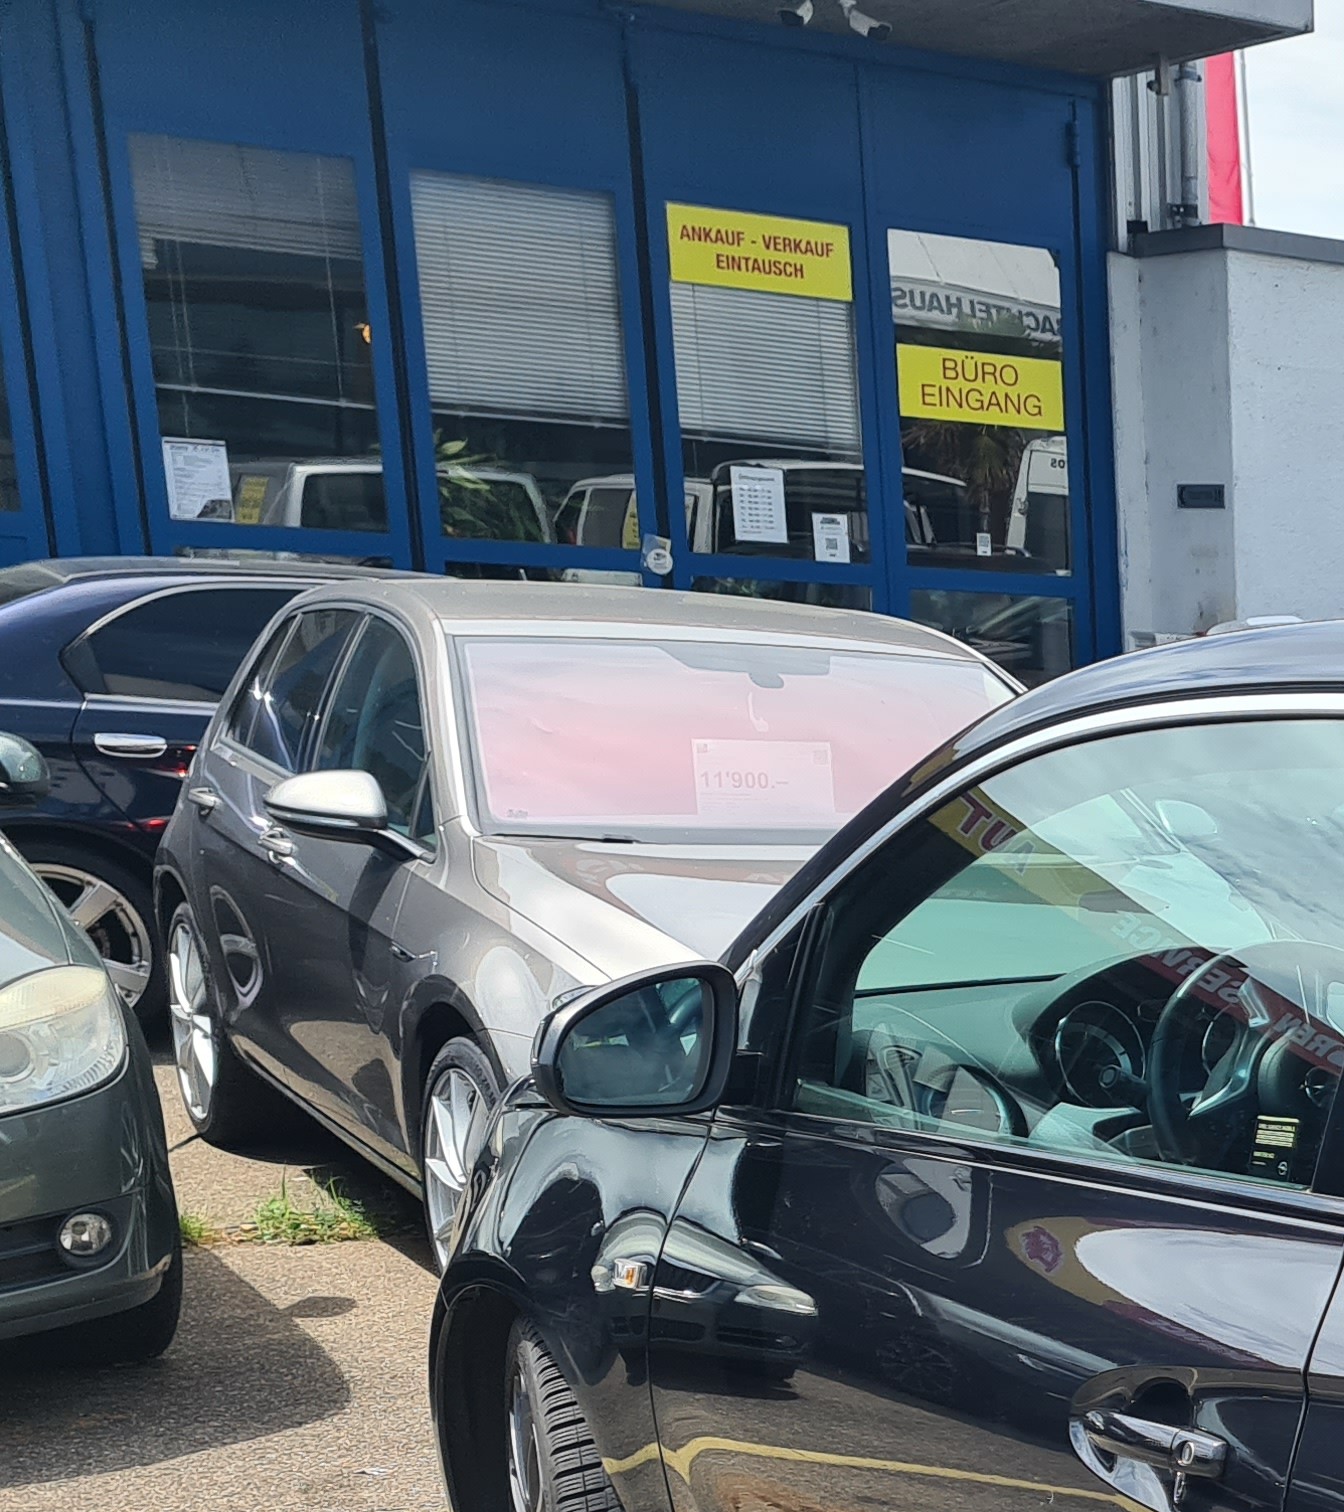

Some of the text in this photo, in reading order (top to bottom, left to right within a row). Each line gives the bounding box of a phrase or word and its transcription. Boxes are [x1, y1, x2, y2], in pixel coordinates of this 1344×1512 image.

[680, 224, 745, 248] ANKAUF
[762, 234, 834, 258] VERKAUF
[716, 253, 804, 279] EINTAUSCH
[942, 355, 1019, 387] BÜRO
[921, 383, 1043, 417] EINGANG
